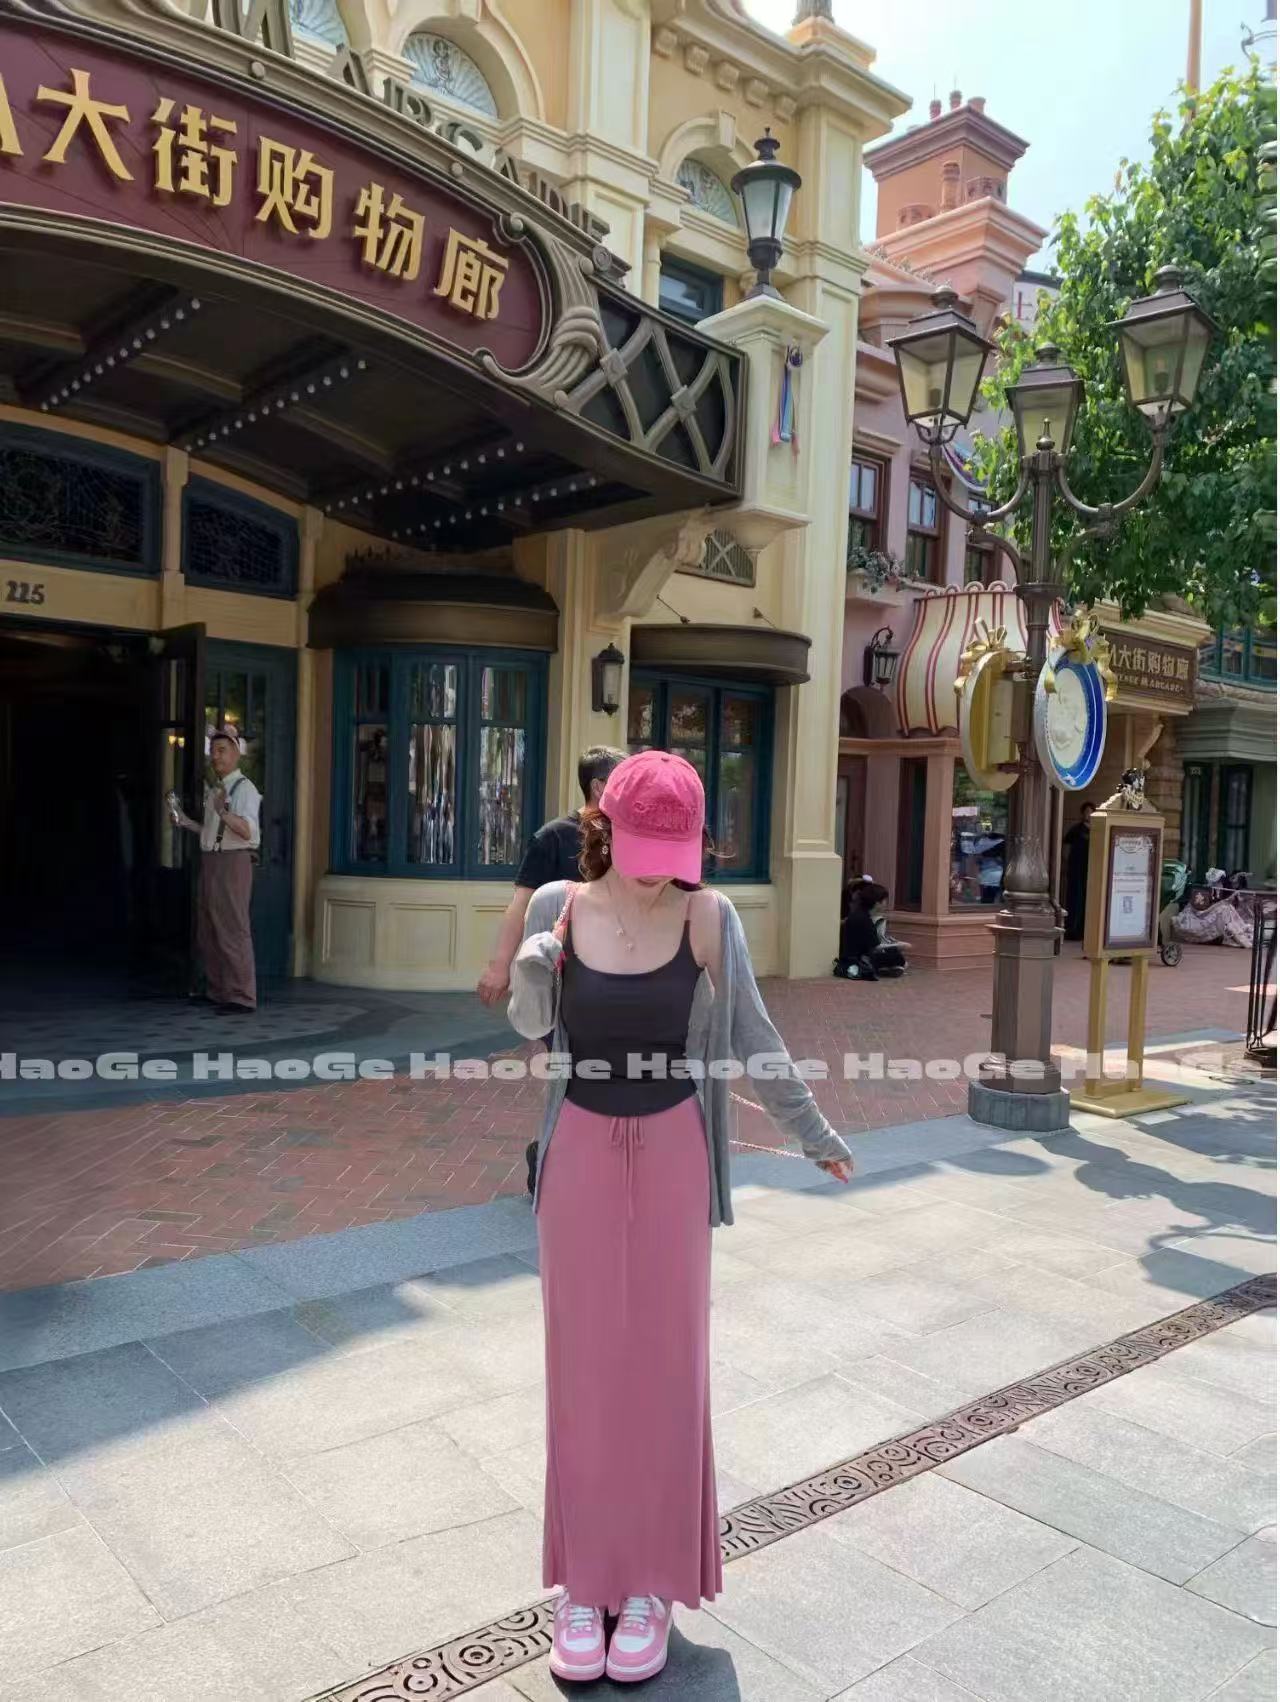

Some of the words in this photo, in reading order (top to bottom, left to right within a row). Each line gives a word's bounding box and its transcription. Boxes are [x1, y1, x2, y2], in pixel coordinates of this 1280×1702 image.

[0, 67, 510, 322] 大街购物廊
